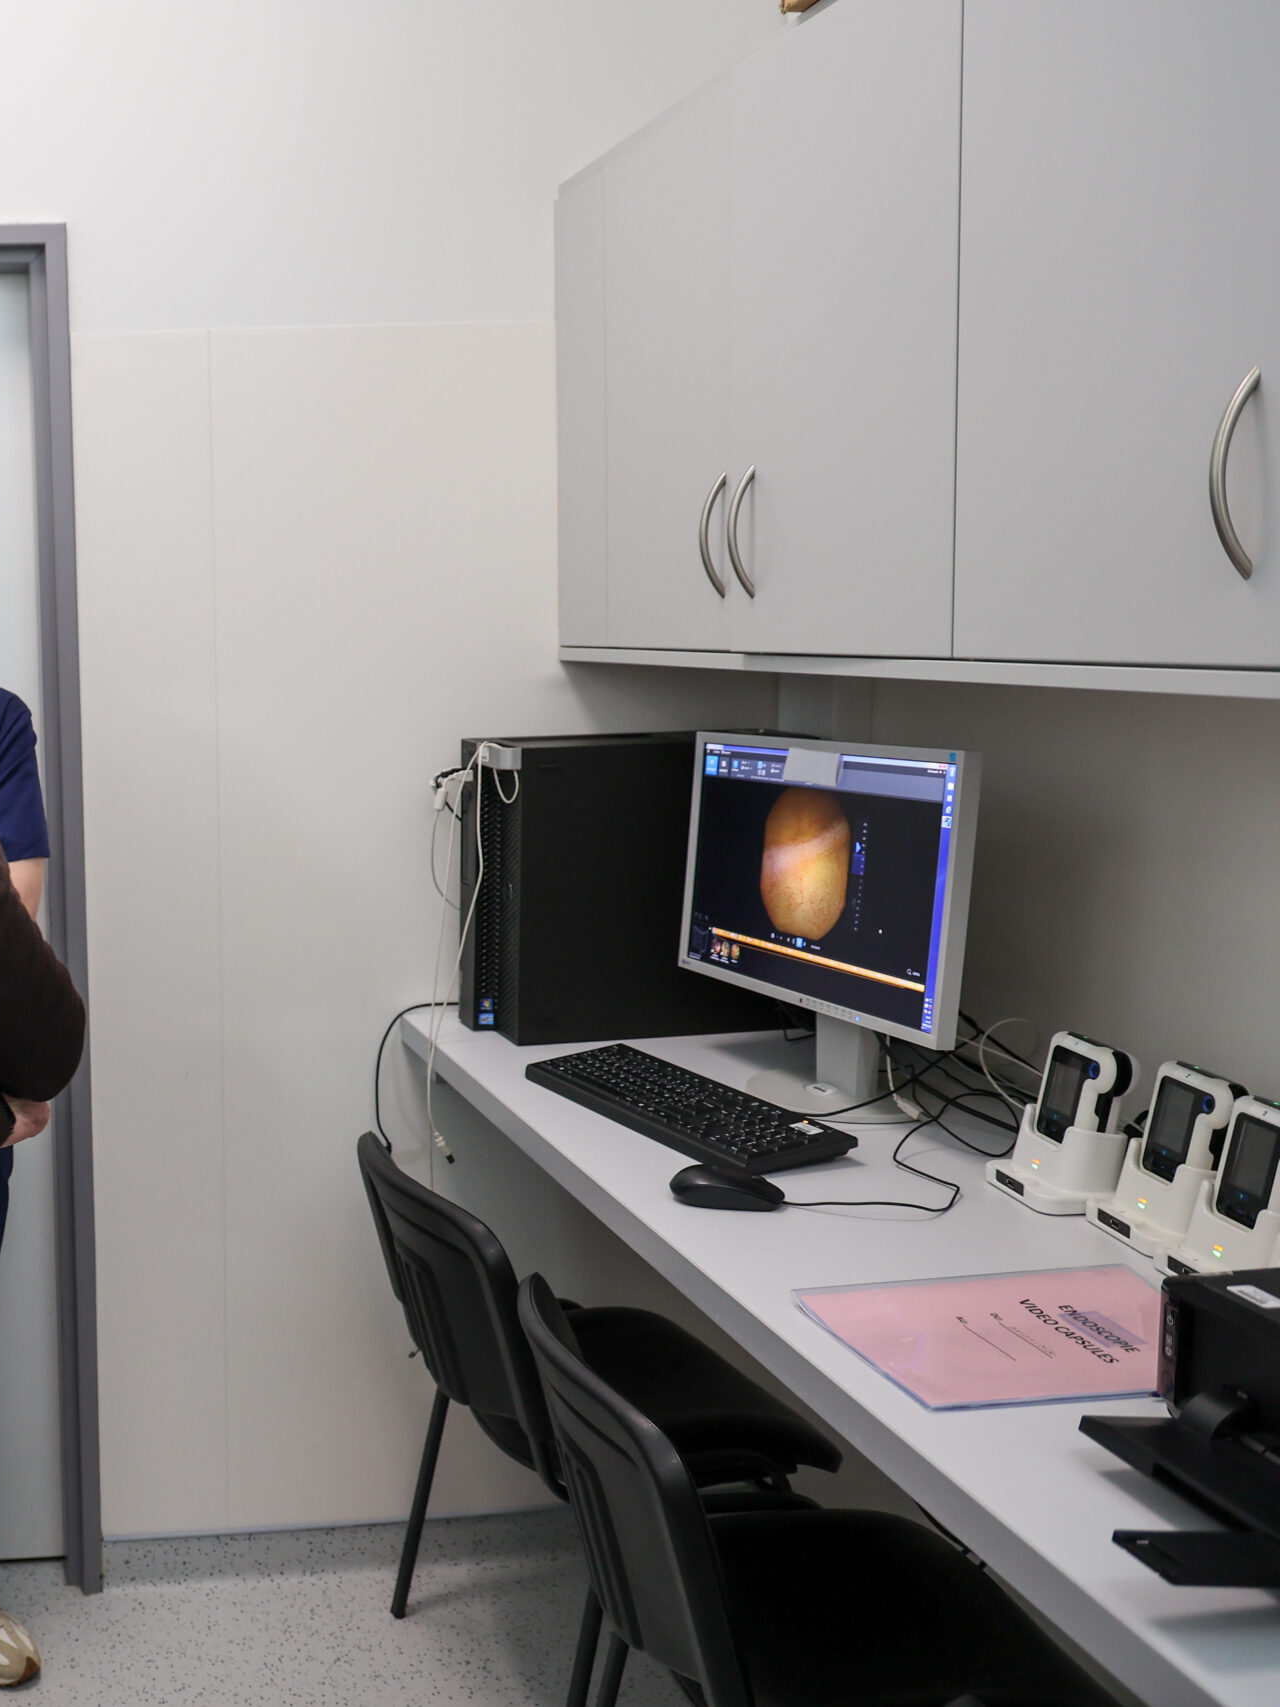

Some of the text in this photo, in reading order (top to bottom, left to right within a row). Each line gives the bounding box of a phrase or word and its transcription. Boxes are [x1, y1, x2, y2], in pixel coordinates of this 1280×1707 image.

[1019, 1298, 1058, 1326] VIDEO
[1054, 1325, 1119, 1365] CAPSULES
[1058, 1304, 1140, 1353] ENDOSCOPIE
